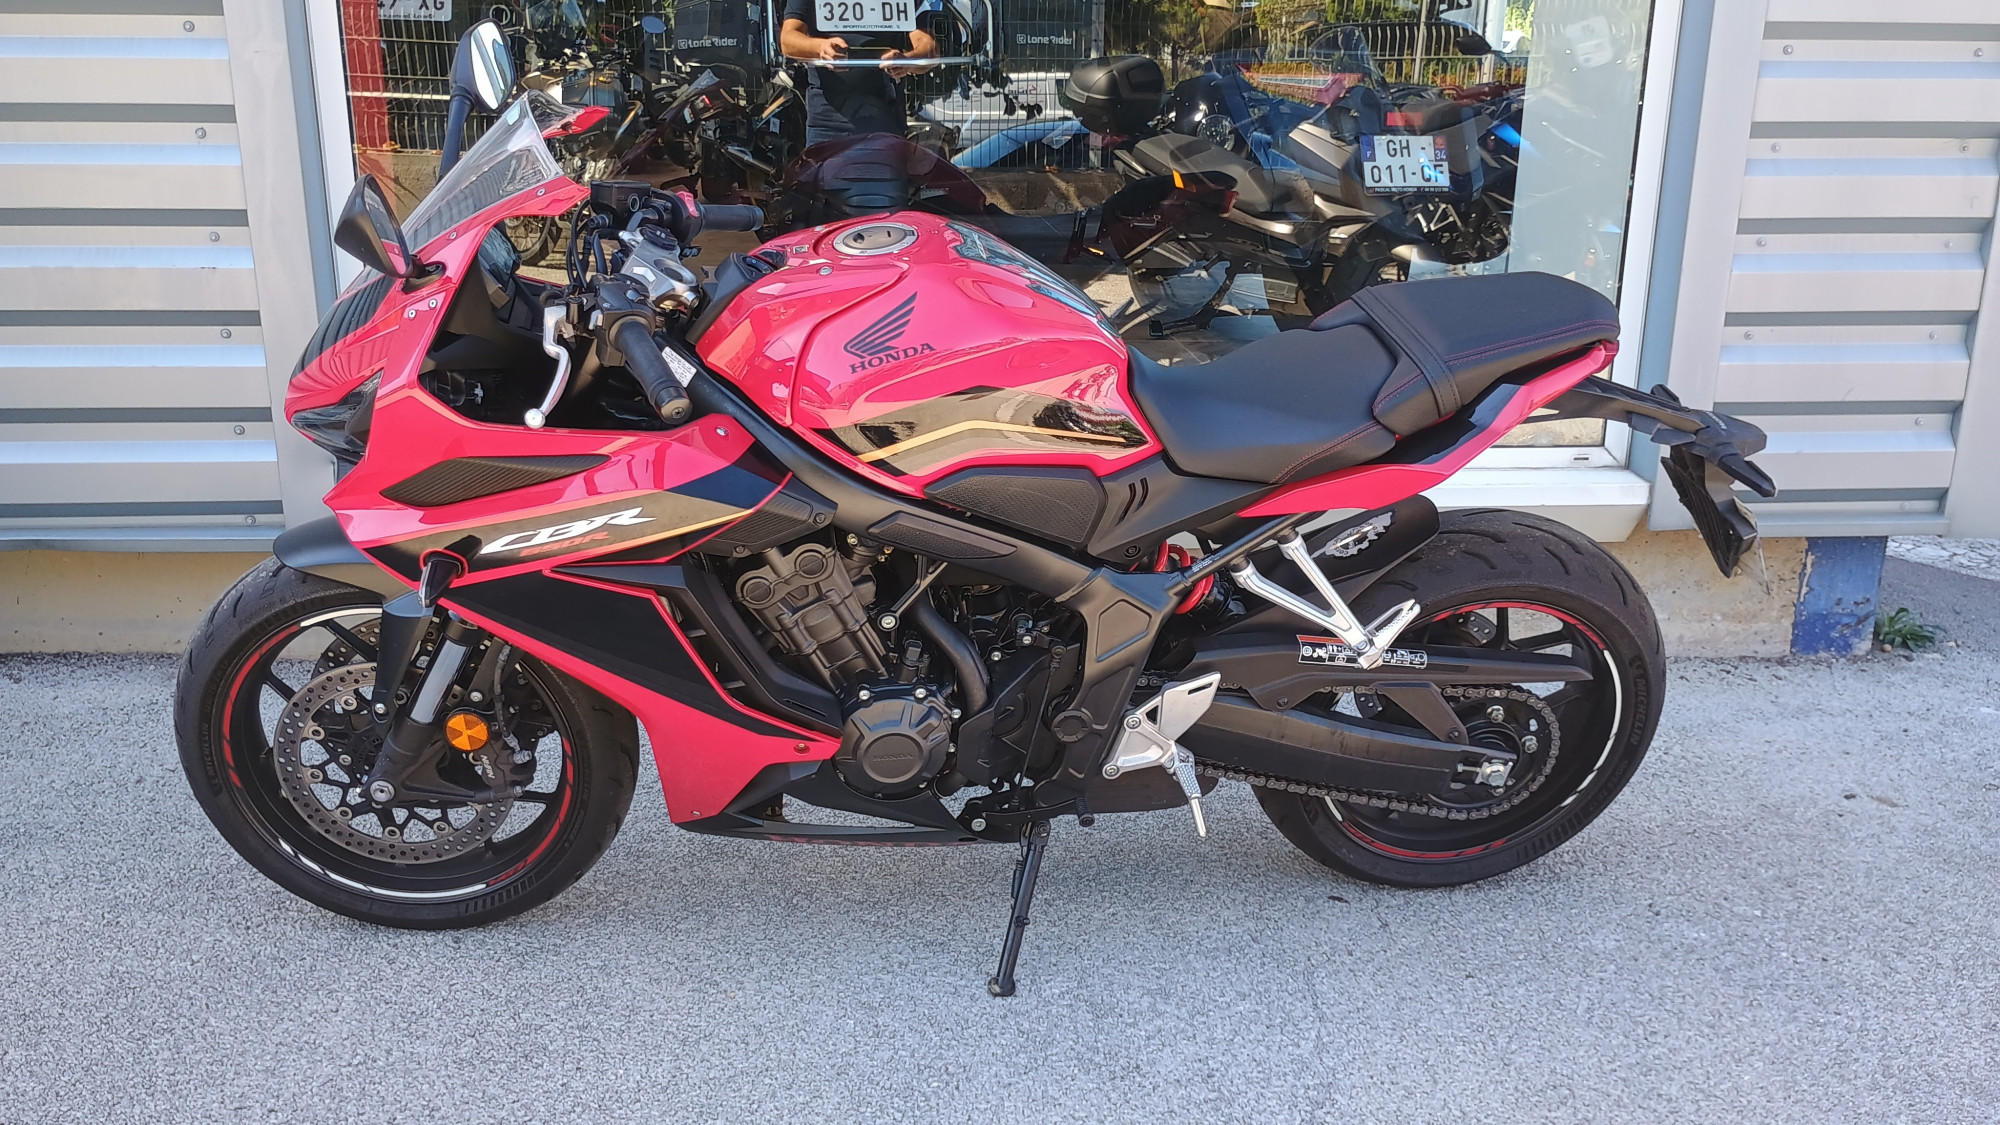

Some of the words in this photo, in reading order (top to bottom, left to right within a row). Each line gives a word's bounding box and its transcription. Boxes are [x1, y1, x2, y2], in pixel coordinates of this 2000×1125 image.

[1386, 139, 1411, 158] GH
[1435, 151, 1447, 160] 34
[849, 343, 938, 374] HONDA
[479, 507, 658, 555] CBR
[1631, 678, 1646, 745] MICHELIN
[873, 753, 916, 761] HONDA
